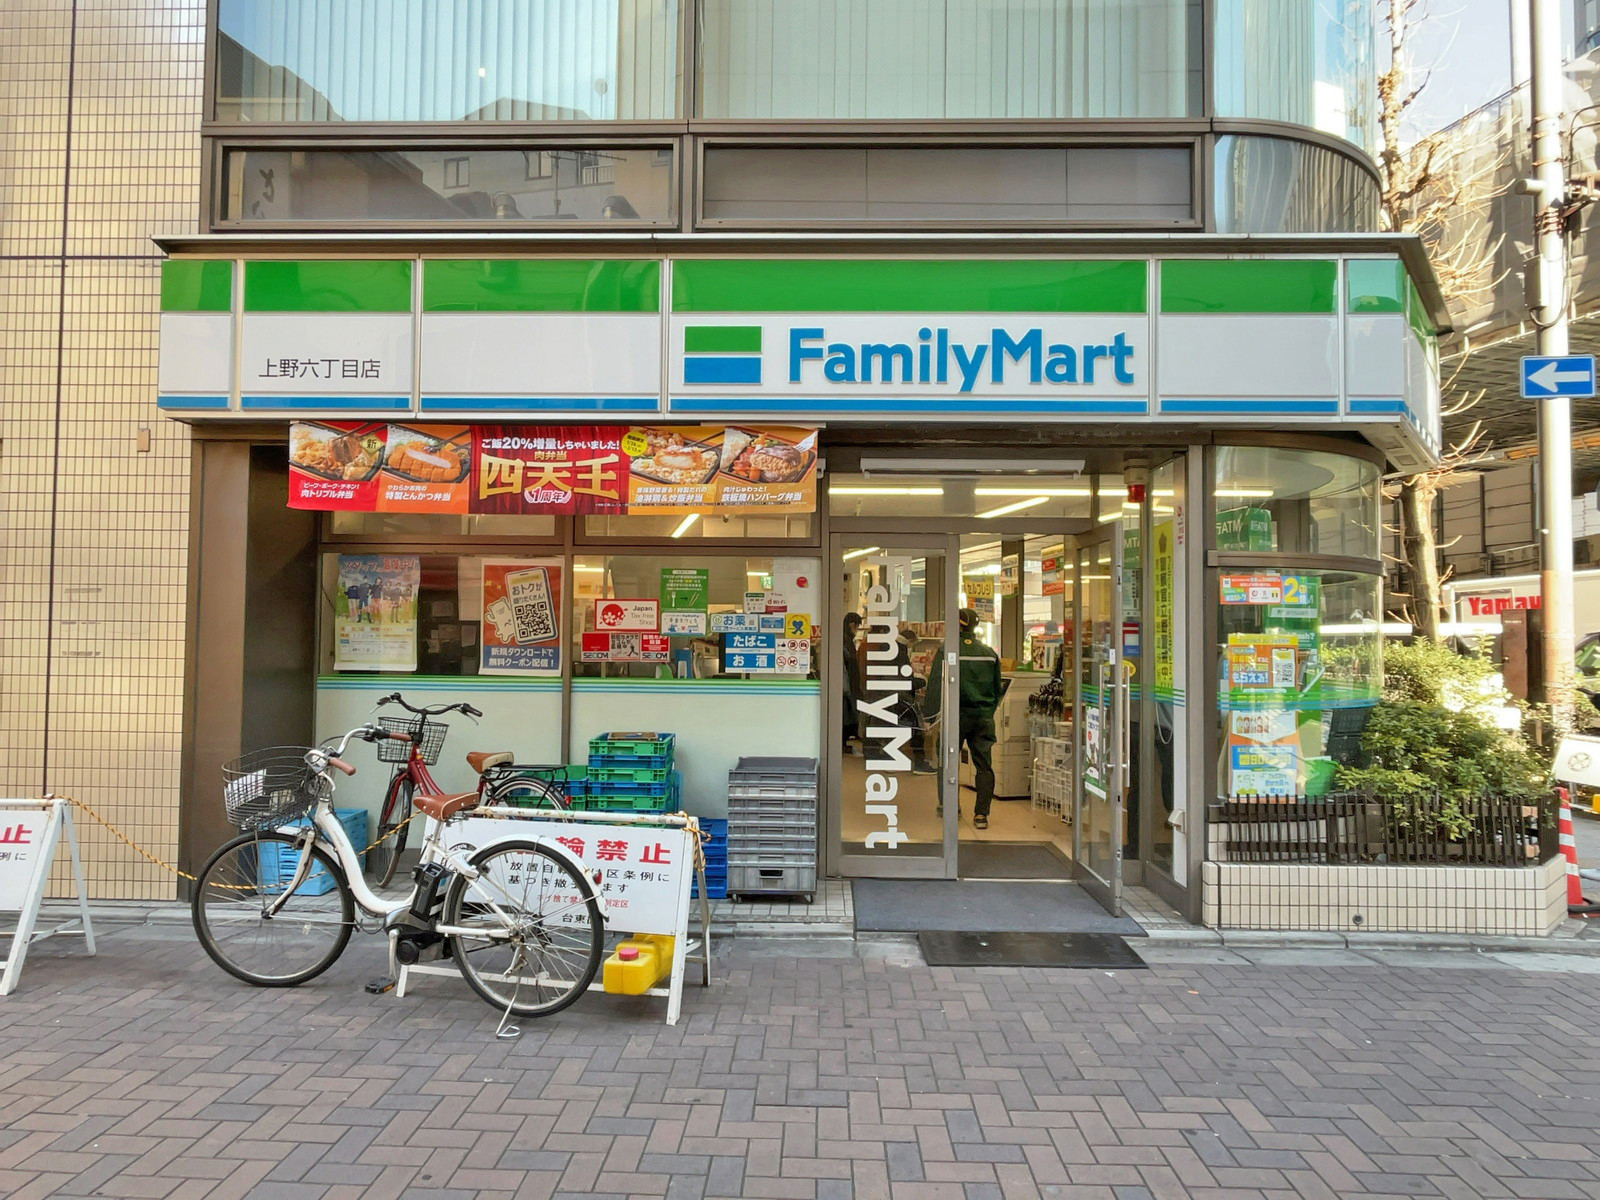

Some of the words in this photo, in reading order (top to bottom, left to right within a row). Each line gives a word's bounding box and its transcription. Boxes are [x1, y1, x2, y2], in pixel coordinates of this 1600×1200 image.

[789, 327, 1134, 393] FamilyMart
[258, 358, 381, 379] 上野六丁目店
[366, 438, 377, 449] 新
[481, 437, 620, 450] ご飯20%増量しちゃいました!
[534, 450, 567, 460] 肉弁当
[479, 453, 619, 500] 四天王
[300, 489, 354, 499] 肉トリプル弁当
[385, 491, 451, 501] 特製とんかつ弁当
[512, 583, 543, 595] おトクが
[723, 615, 746, 626] お薬
[733, 635, 767, 647] たばこ
[490, 647, 554, 657] 新規ダウンロードで
[488, 658, 554, 668] 無料クーポン配信!
[733, 654, 768, 667] お酒
[857, 556, 912, 849] FamilyMart
[517, 836, 671, 865] 輪禁止
